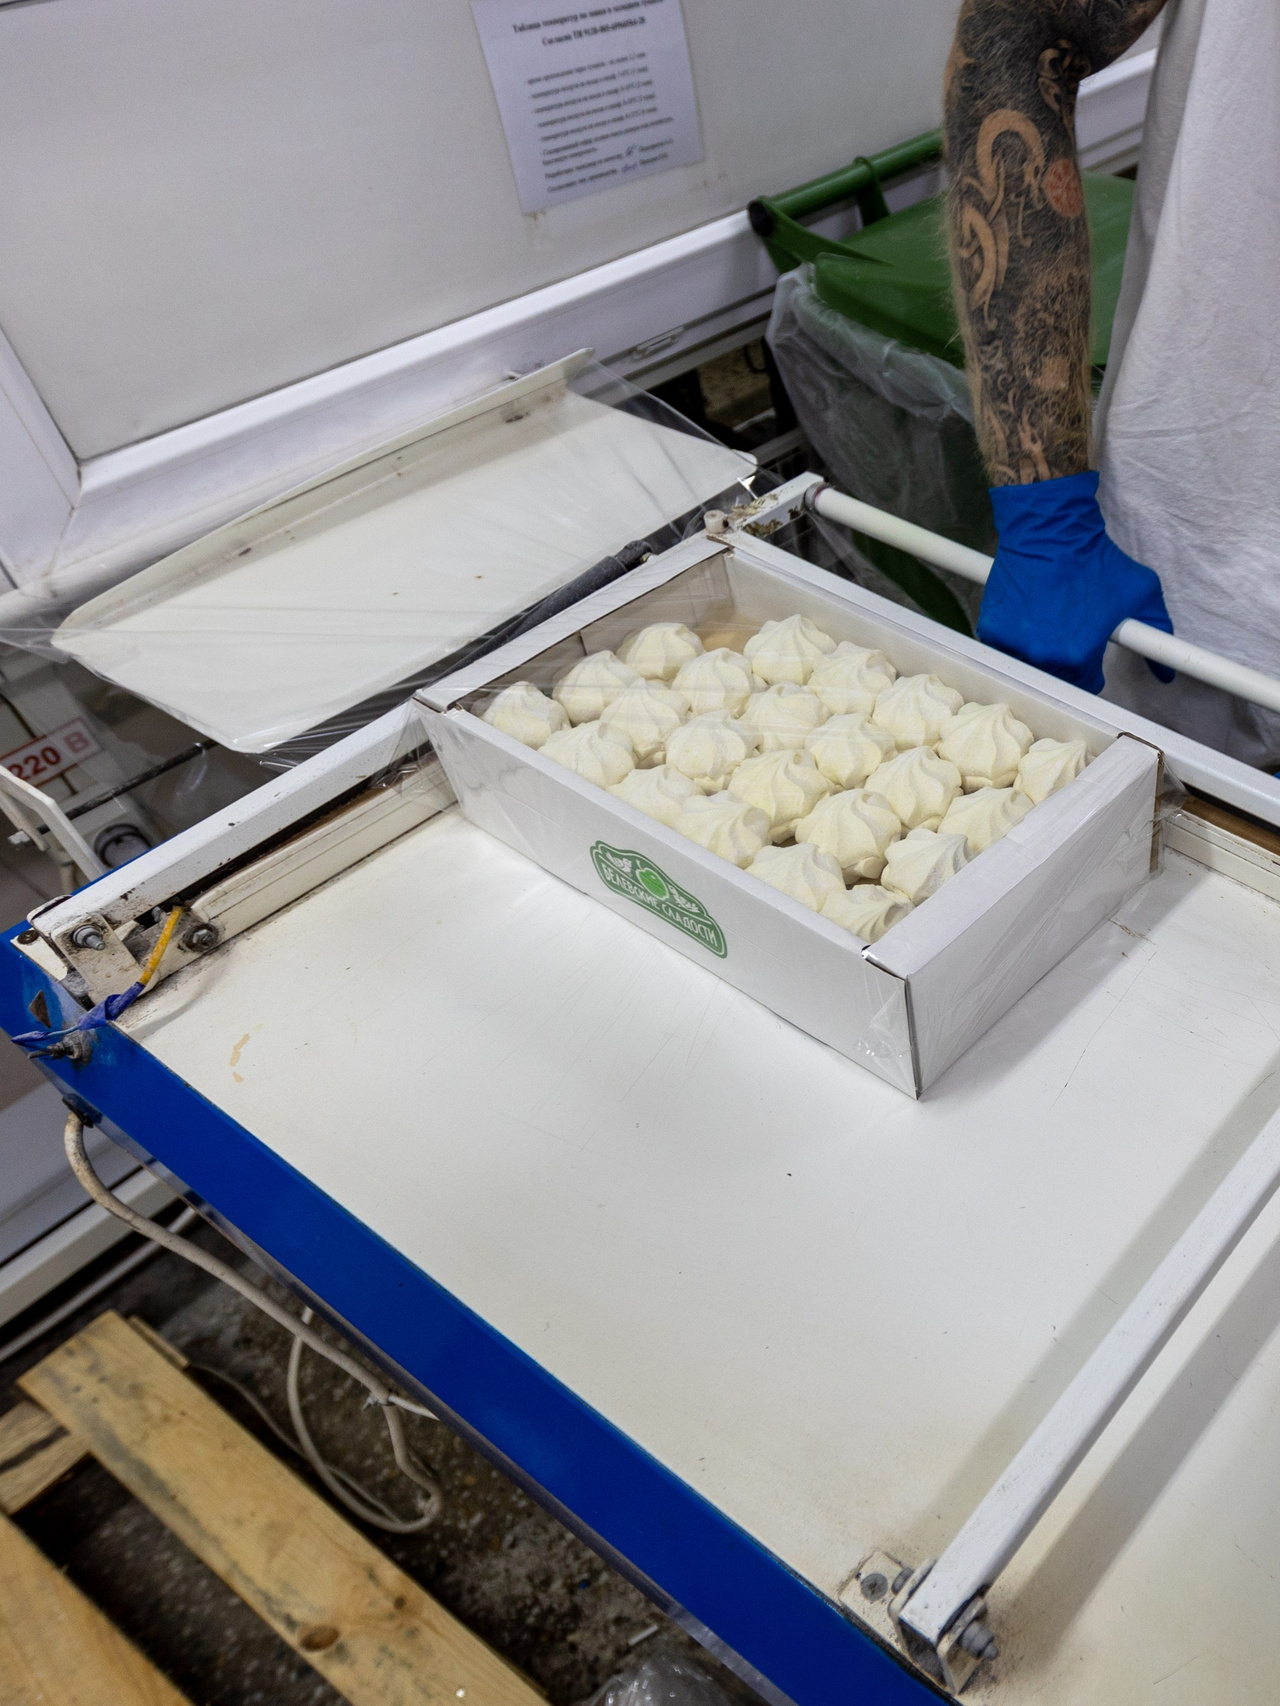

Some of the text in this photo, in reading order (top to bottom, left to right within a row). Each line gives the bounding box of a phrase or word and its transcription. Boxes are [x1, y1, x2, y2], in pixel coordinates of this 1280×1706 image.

[8, 731, 89, 781] 220 В
[601, 863, 718, 947] БЕЛЕВСКИЕ СЛАДОСТИ
